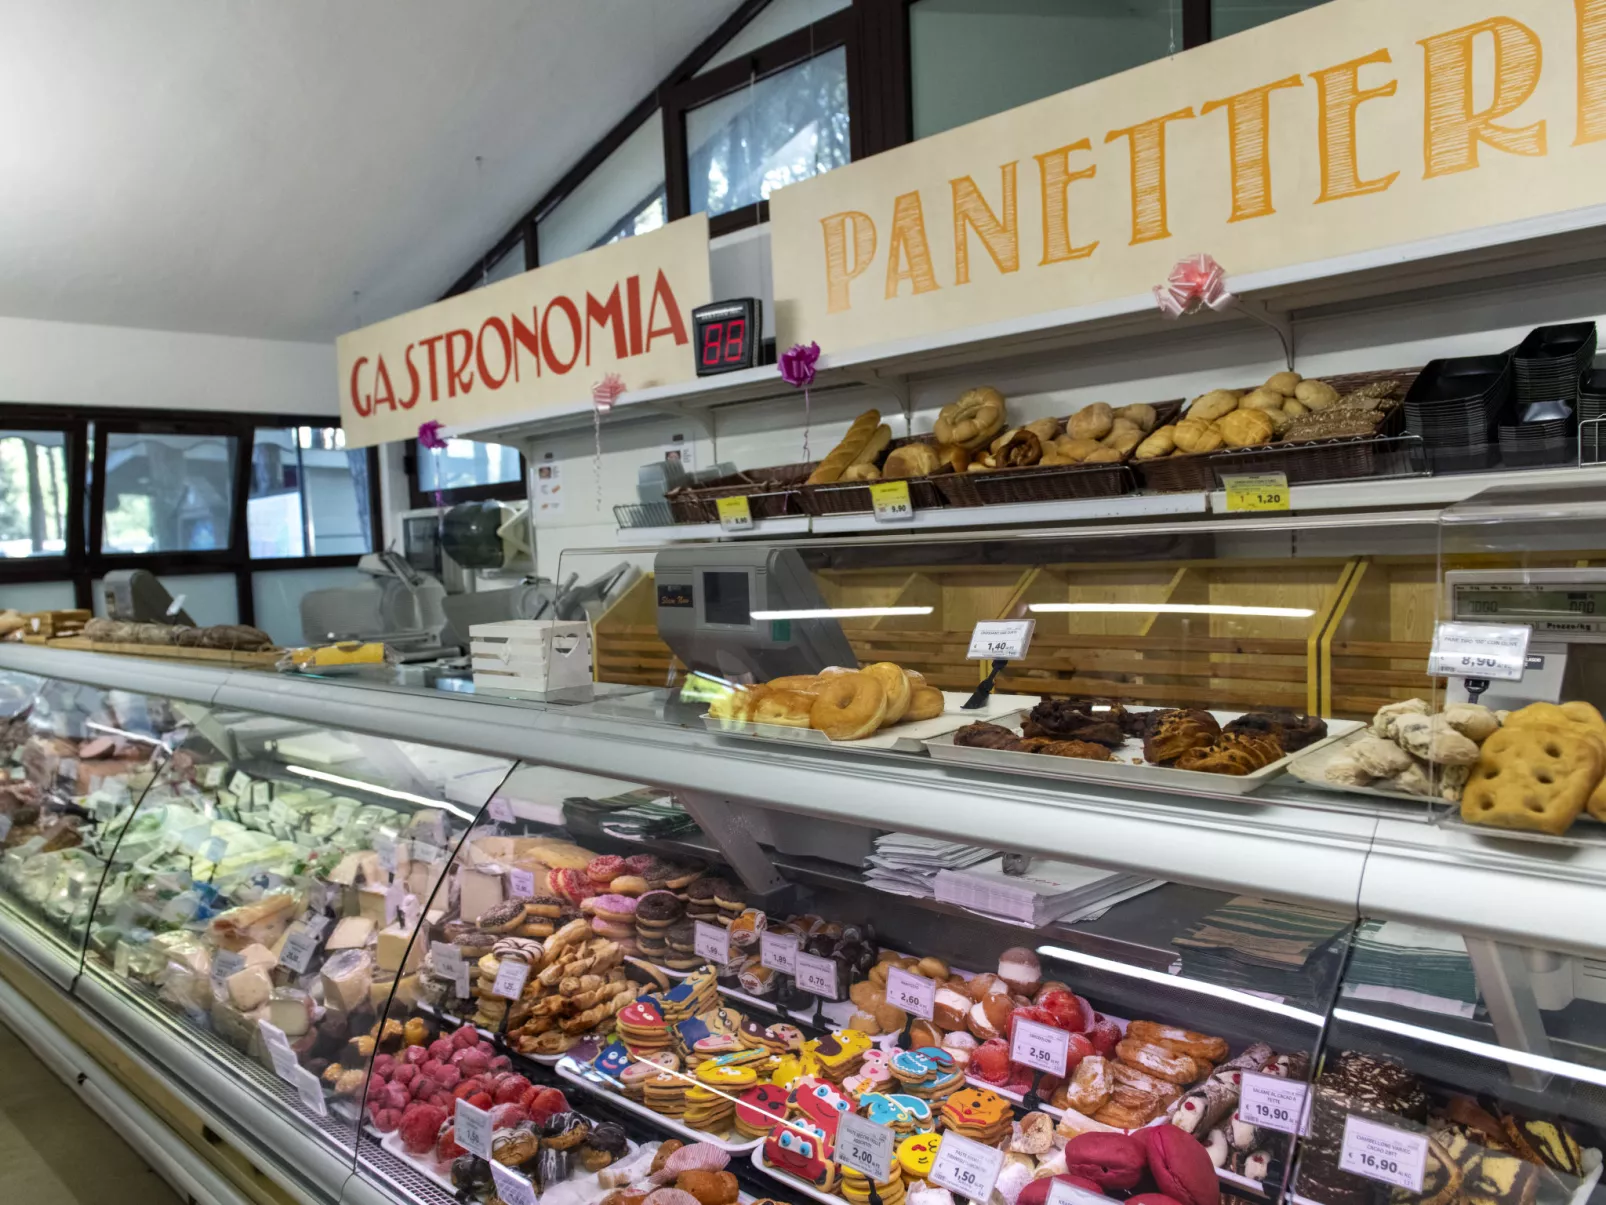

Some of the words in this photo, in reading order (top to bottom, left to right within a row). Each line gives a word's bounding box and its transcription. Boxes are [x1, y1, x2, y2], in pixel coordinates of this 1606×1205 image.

[351, 267, 689, 418] GASTRONOMIA
[703, 320, 745, 365] 88
[1257, 494, 1281, 504] 1,20
[987, 643, 1006, 653] 1,40
[808, 975, 825, 986] 0,70
[901, 992, 919, 1006] 2,60
[1030, 1047, 1051, 1061] 2,50
[1256, 1104, 1288, 1121] 19,90
[852, 1147, 872, 1164] 2,00
[1360, 1153, 1397, 1173] 16,90
[954, 1167, 976, 1185] 1,50
